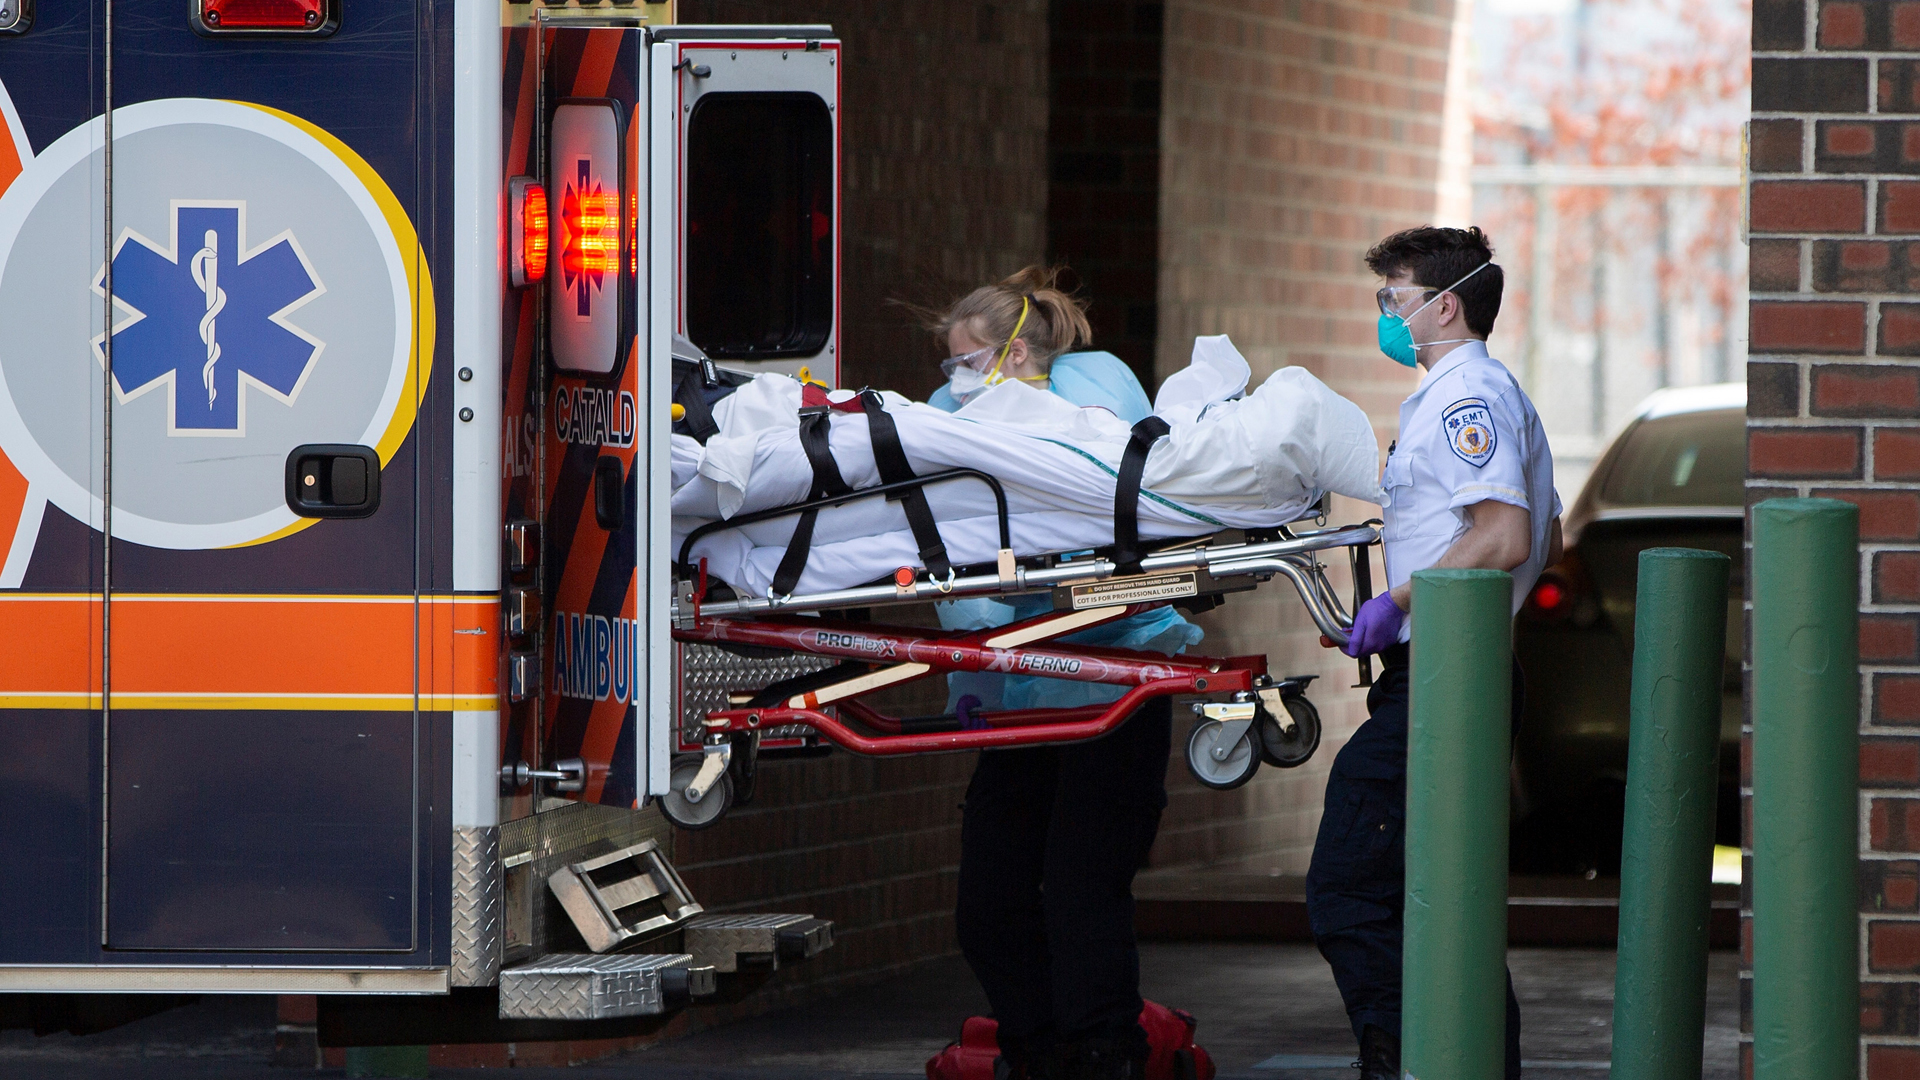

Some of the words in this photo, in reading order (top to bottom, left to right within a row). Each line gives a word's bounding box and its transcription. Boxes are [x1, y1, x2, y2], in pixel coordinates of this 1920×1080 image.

[555, 385, 636, 448] CATALD
[1462, 411, 1483, 424] EMT
[503, 412, 534, 478] ALS
[1098, 594, 1111, 602] FOR
[1112, 589, 1160, 600] PROFESSIONAL
[1161, 587, 1174, 595] USE
[1175, 585, 1192, 593] ONLY
[1114, 582, 1135, 590] REMOVE
[1019, 653, 1082, 674] FERNO
